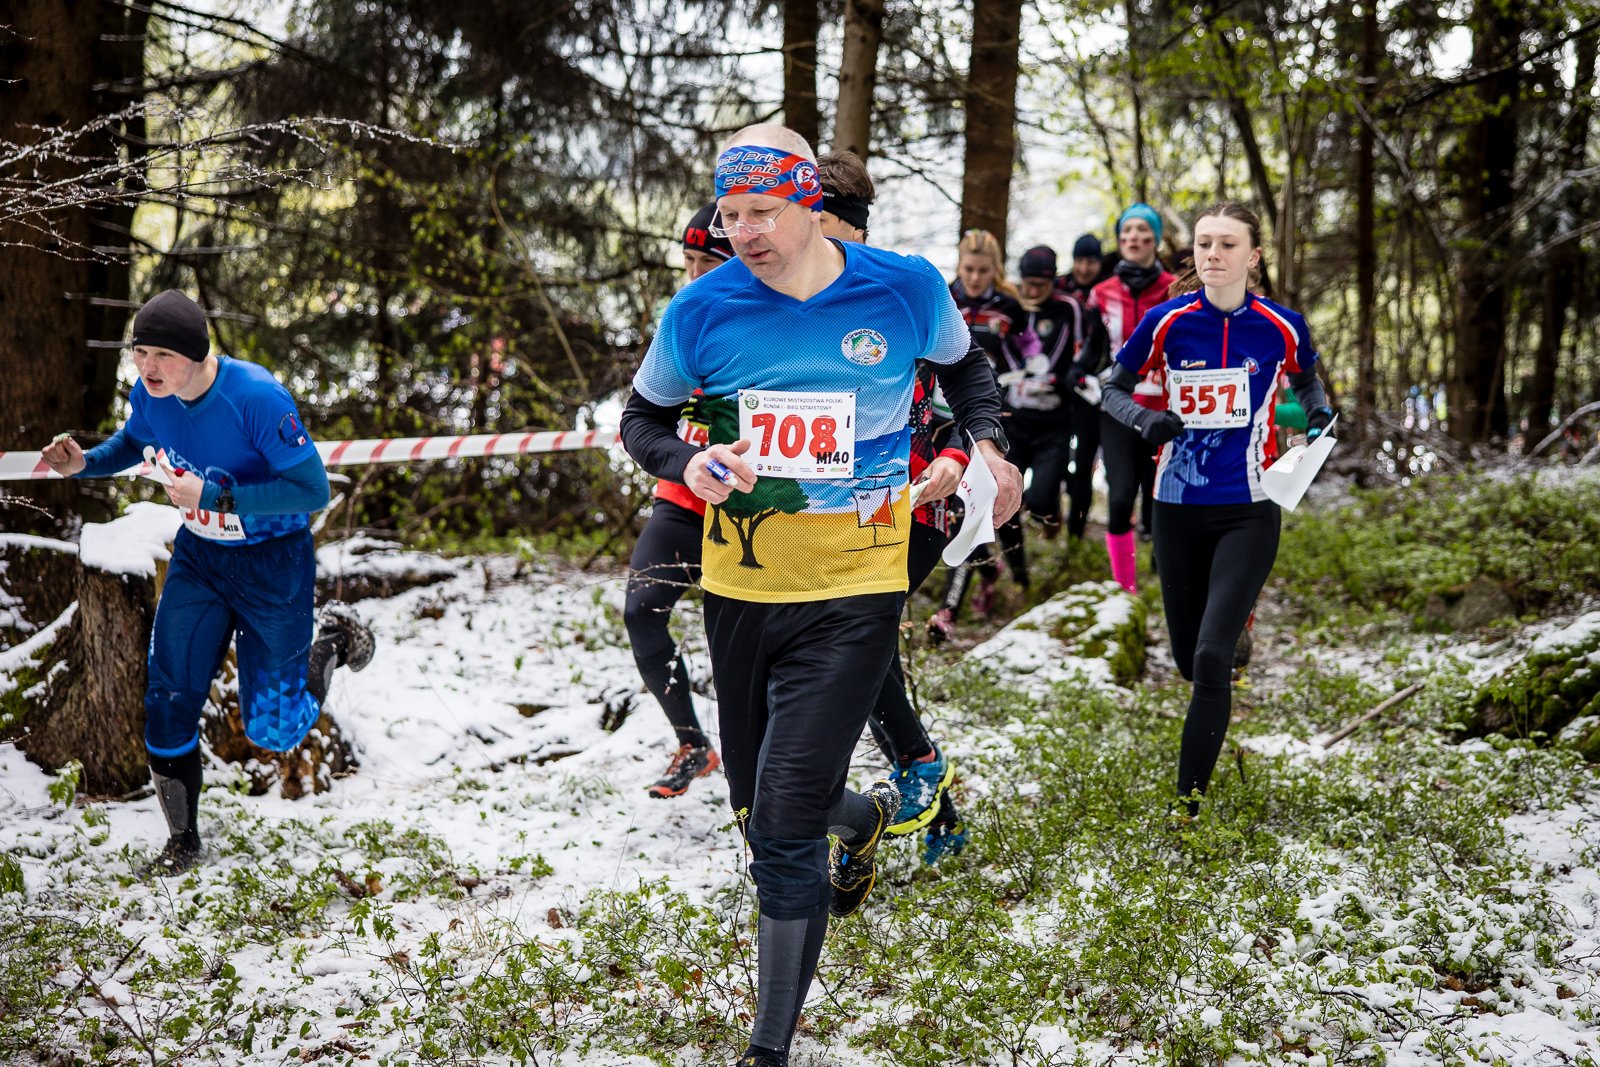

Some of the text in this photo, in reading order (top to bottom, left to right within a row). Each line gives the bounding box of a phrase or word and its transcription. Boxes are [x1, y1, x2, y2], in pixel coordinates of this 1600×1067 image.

[743, 152, 783, 165] Prix
[717, 162, 781, 177] Polonia
[723, 175, 780, 189] 2020
[1180, 384, 1237, 415] 557
[1231, 408, 1247, 418] K18
[752, 413, 838, 459] 708
[816, 451, 850, 465] M140
